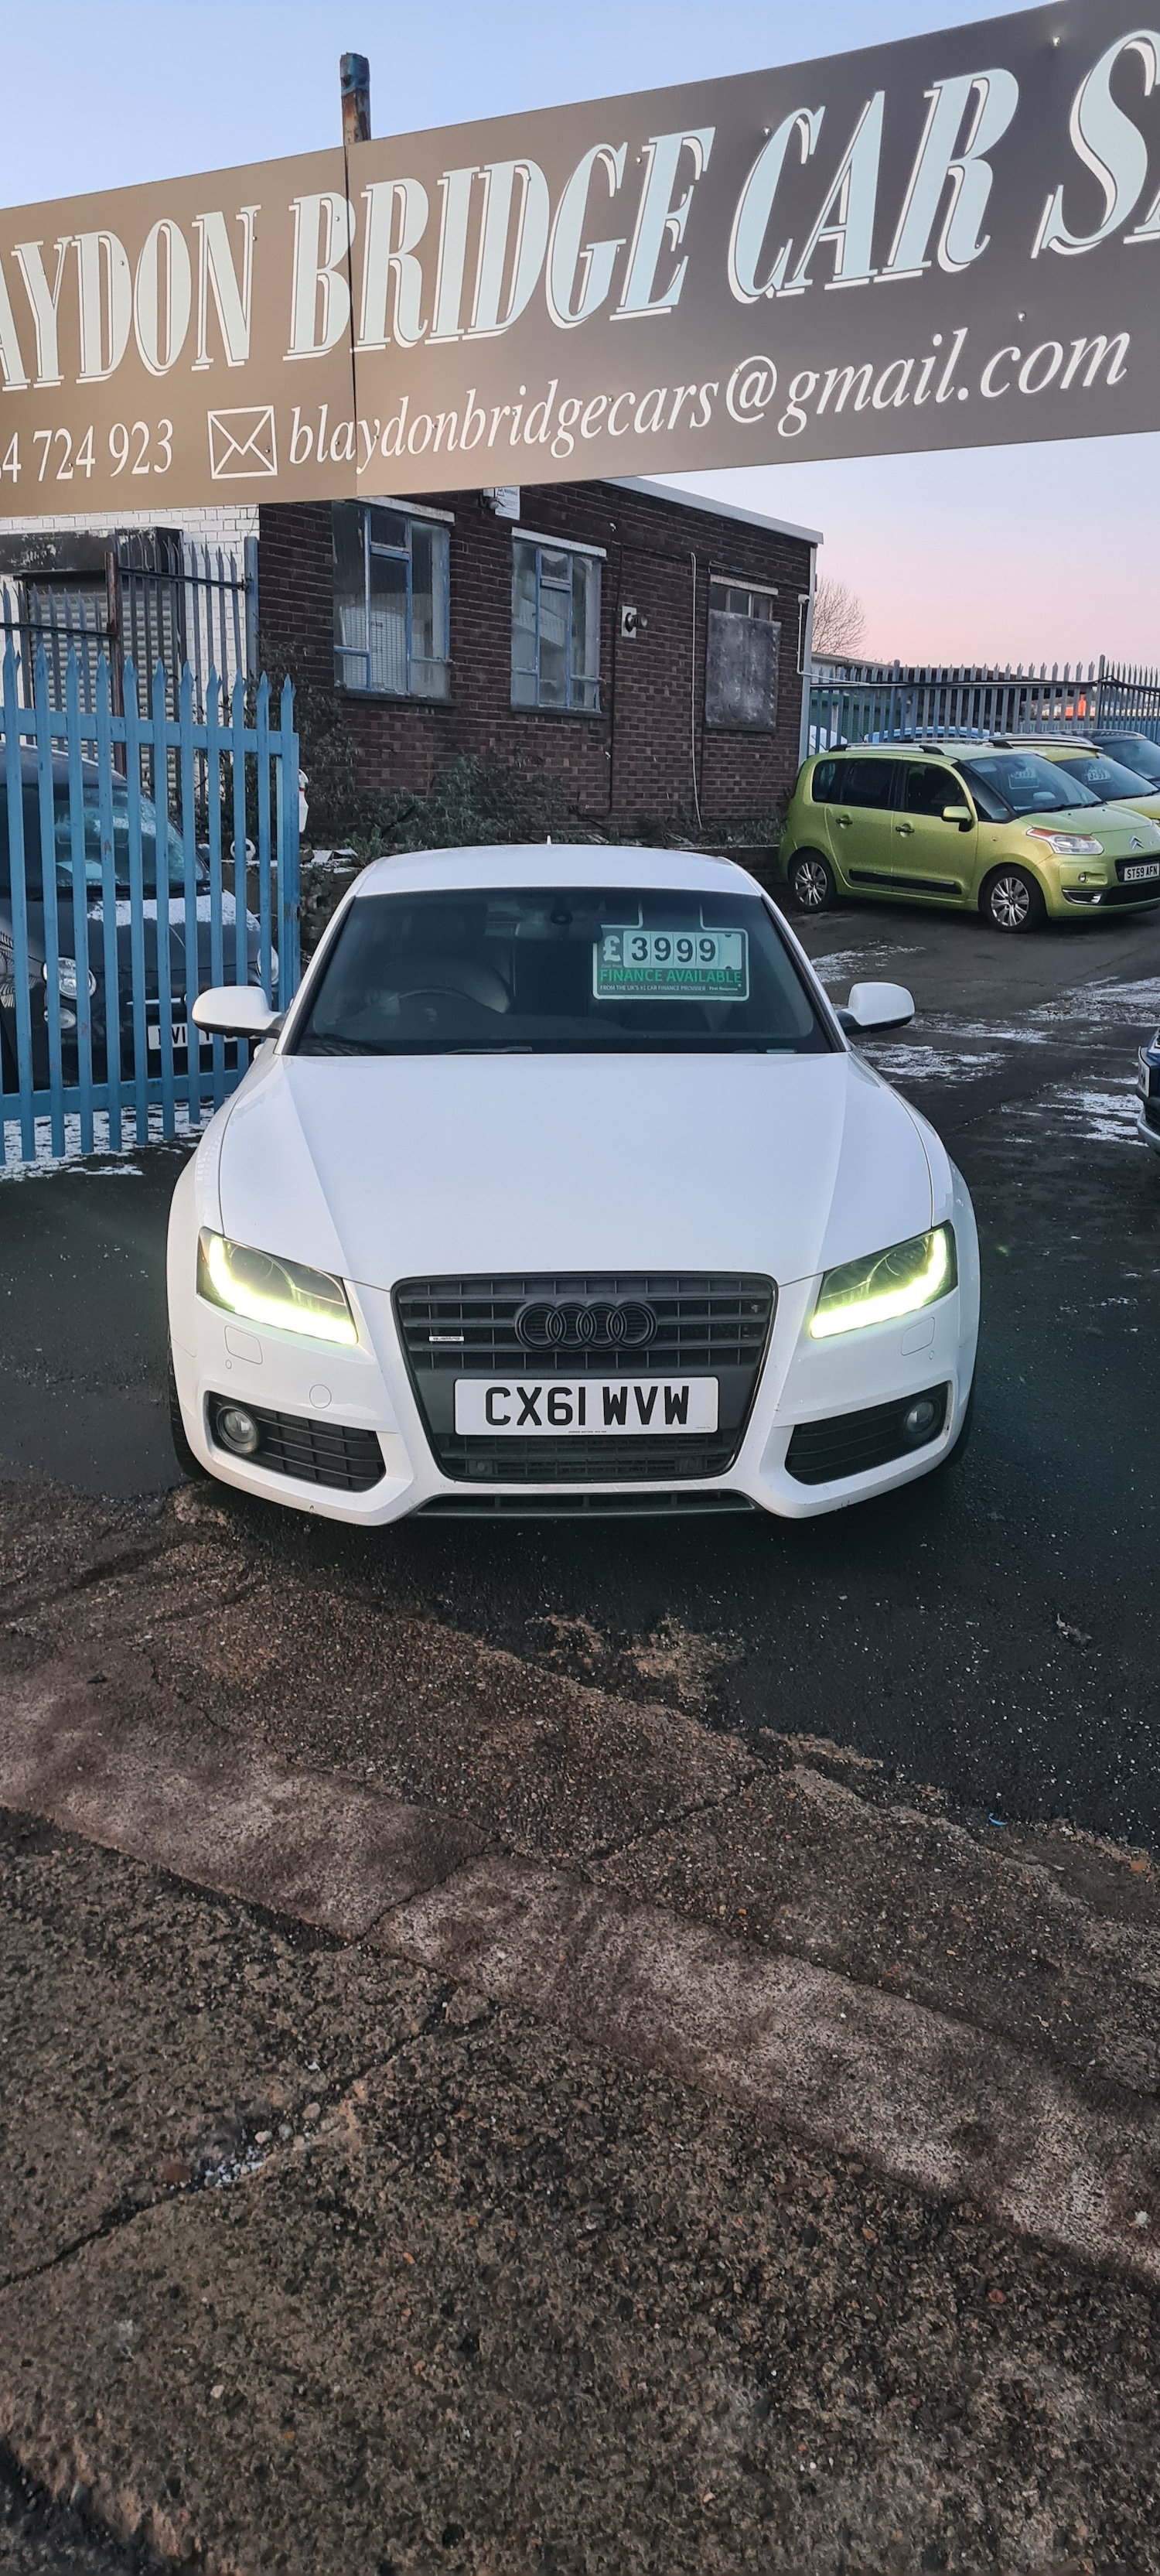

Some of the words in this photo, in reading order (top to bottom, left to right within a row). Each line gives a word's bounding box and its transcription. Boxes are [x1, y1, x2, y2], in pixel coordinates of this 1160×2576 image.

[282, 126, 716, 362] BRIDGE
[728, 67, 1019, 304] CAR
[1030, 29, 1160, 259] S
[288, 327, 1131, 474] blaydonbridgecars@gmail.com
[0, 432, 22, 483] 4
[32, 425, 96, 482] 724
[109, 419, 174, 477] 923
[1127, 867, 1145, 879] ST59
[1145, 865, 1158, 876] AFN
[599, 969, 663, 982] FINANCE
[666, 969, 742, 983] AVAILABLE
[485, 1386, 586, 1426] CX61
[602, 1385, 690, 1425] WVW
